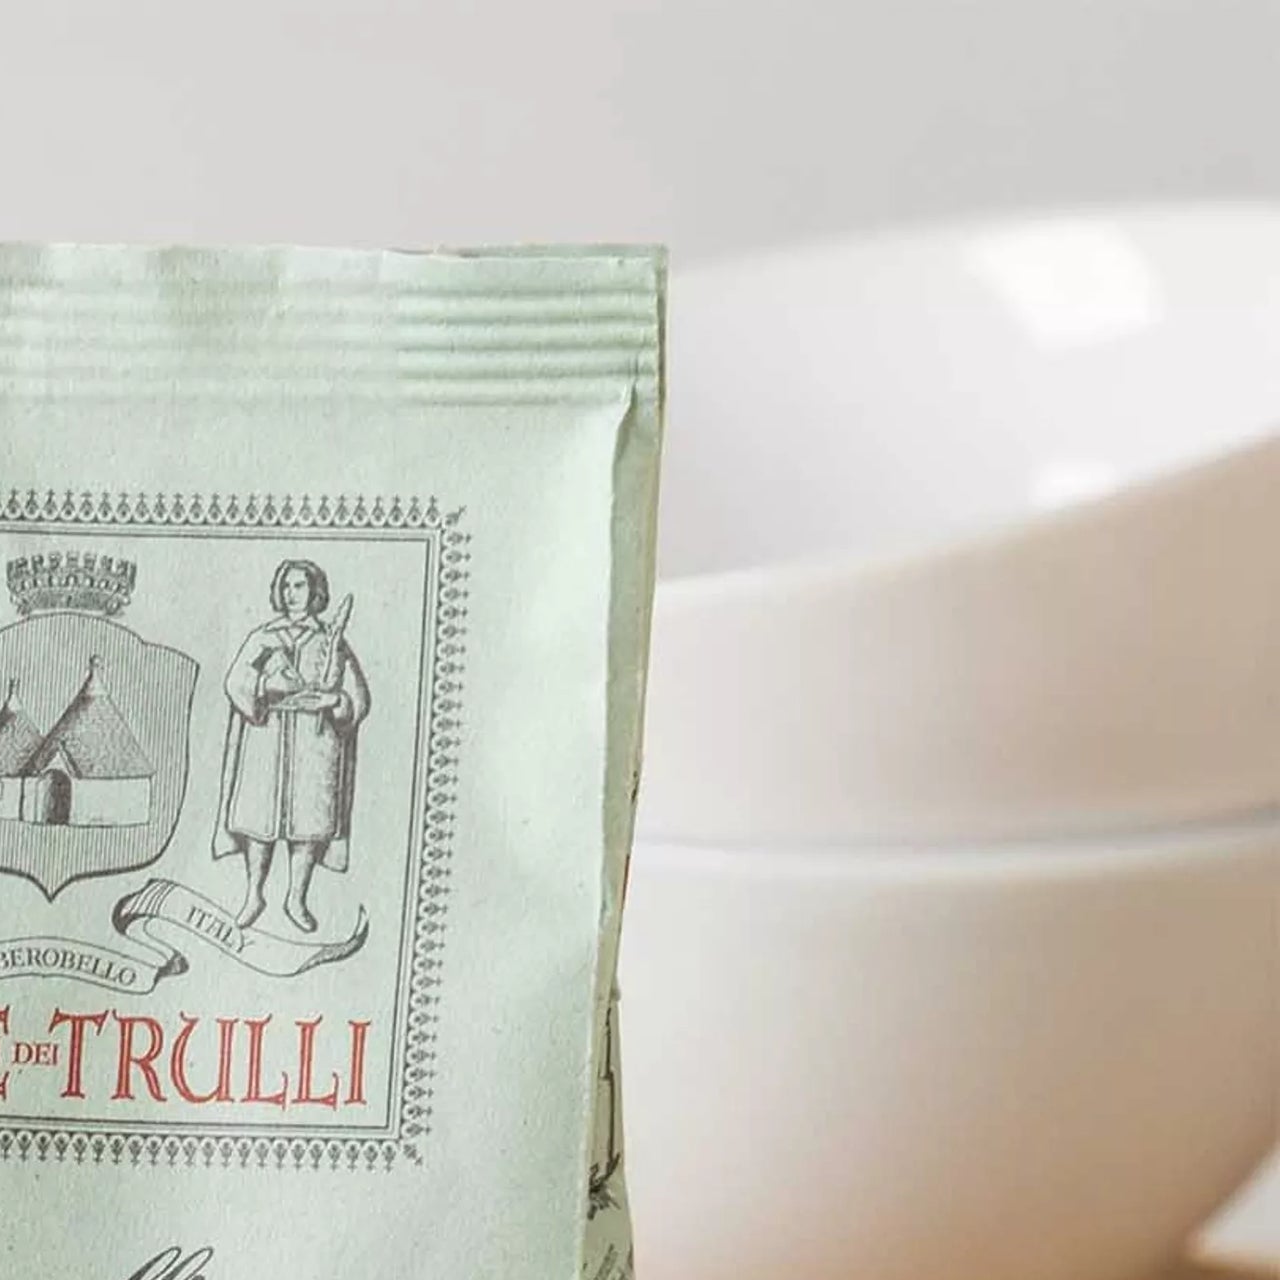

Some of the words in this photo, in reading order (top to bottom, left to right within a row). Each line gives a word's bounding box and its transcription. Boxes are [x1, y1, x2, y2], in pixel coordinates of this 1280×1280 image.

[185, 905, 256, 954] ITALY
[11, 1041, 58, 1067] DEI
[48, 1006, 372, 1112] TRULLI
